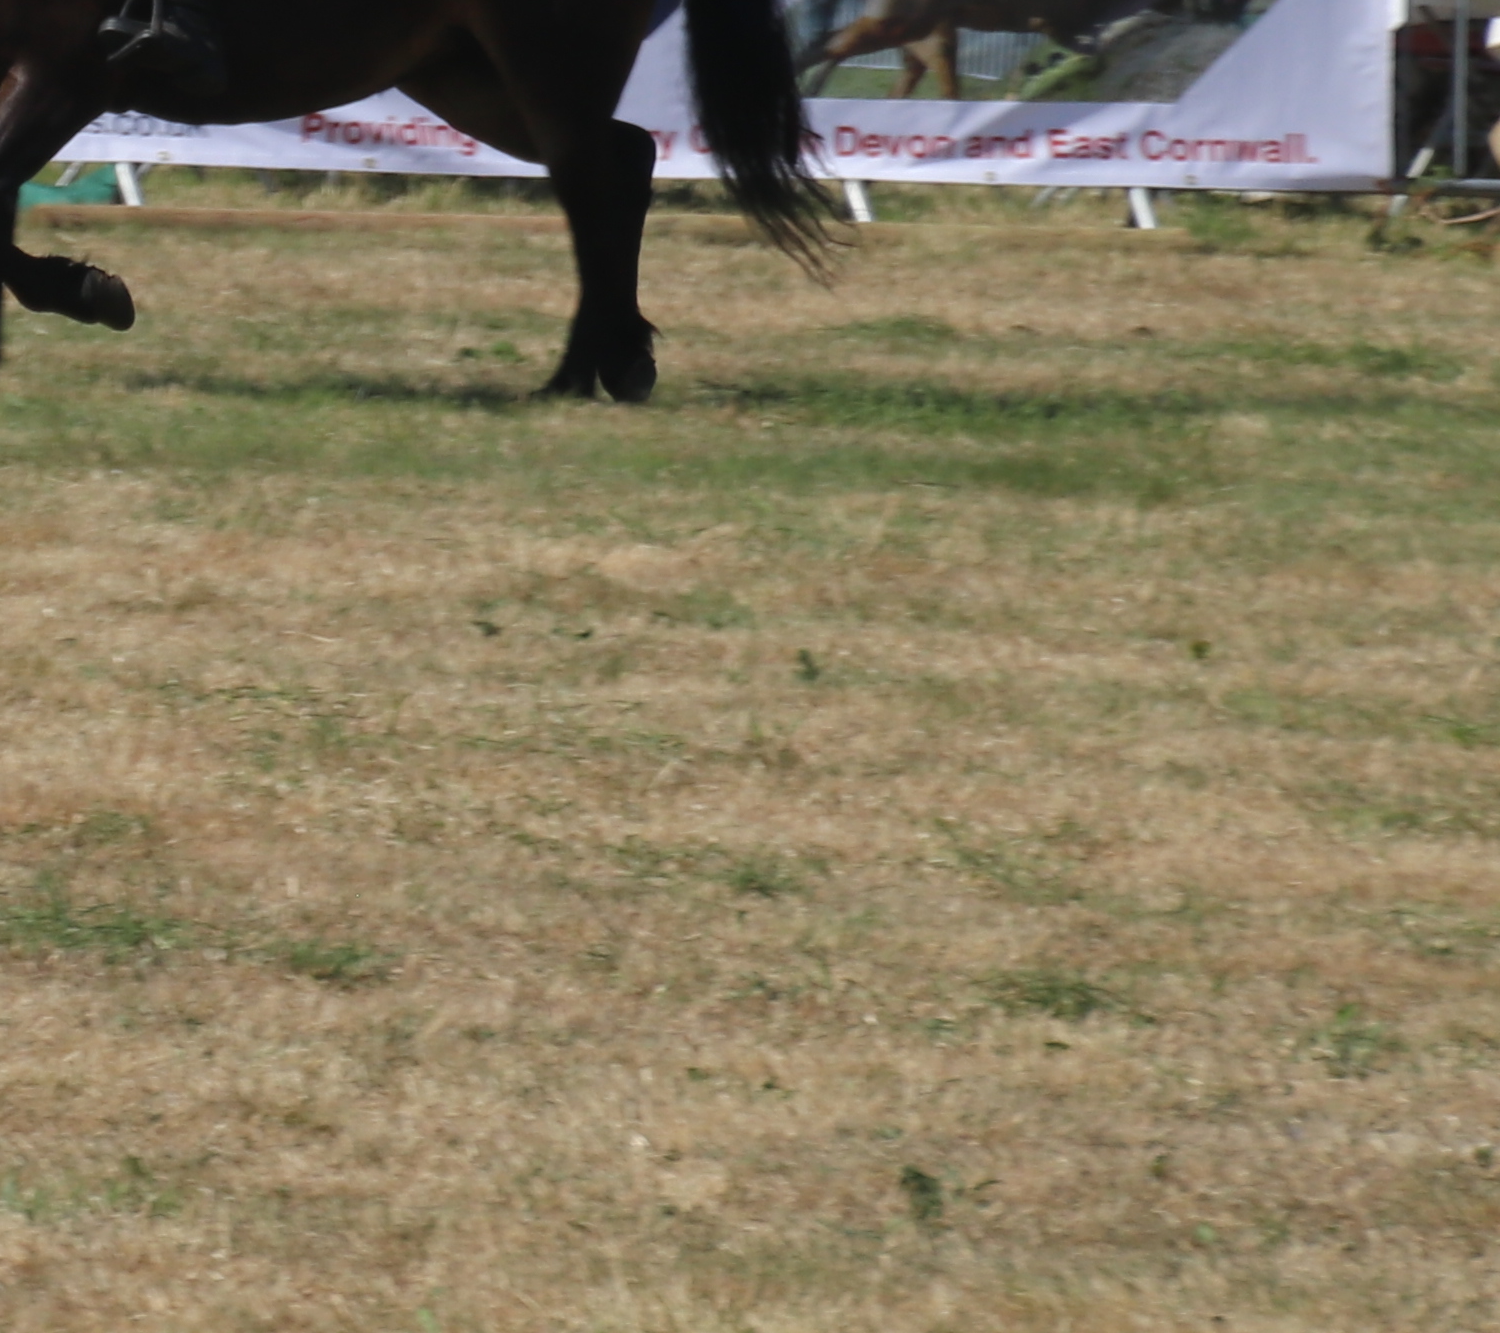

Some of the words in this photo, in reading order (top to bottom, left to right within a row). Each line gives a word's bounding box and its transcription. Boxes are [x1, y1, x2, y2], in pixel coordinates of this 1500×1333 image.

[302, 112, 477, 156] Providing
[834, 125, 952, 159] Devon
[967, 129, 1033, 159] and
[1049, 128, 1128, 161] East
[1139, 130, 1319, 164] Cornwall.
